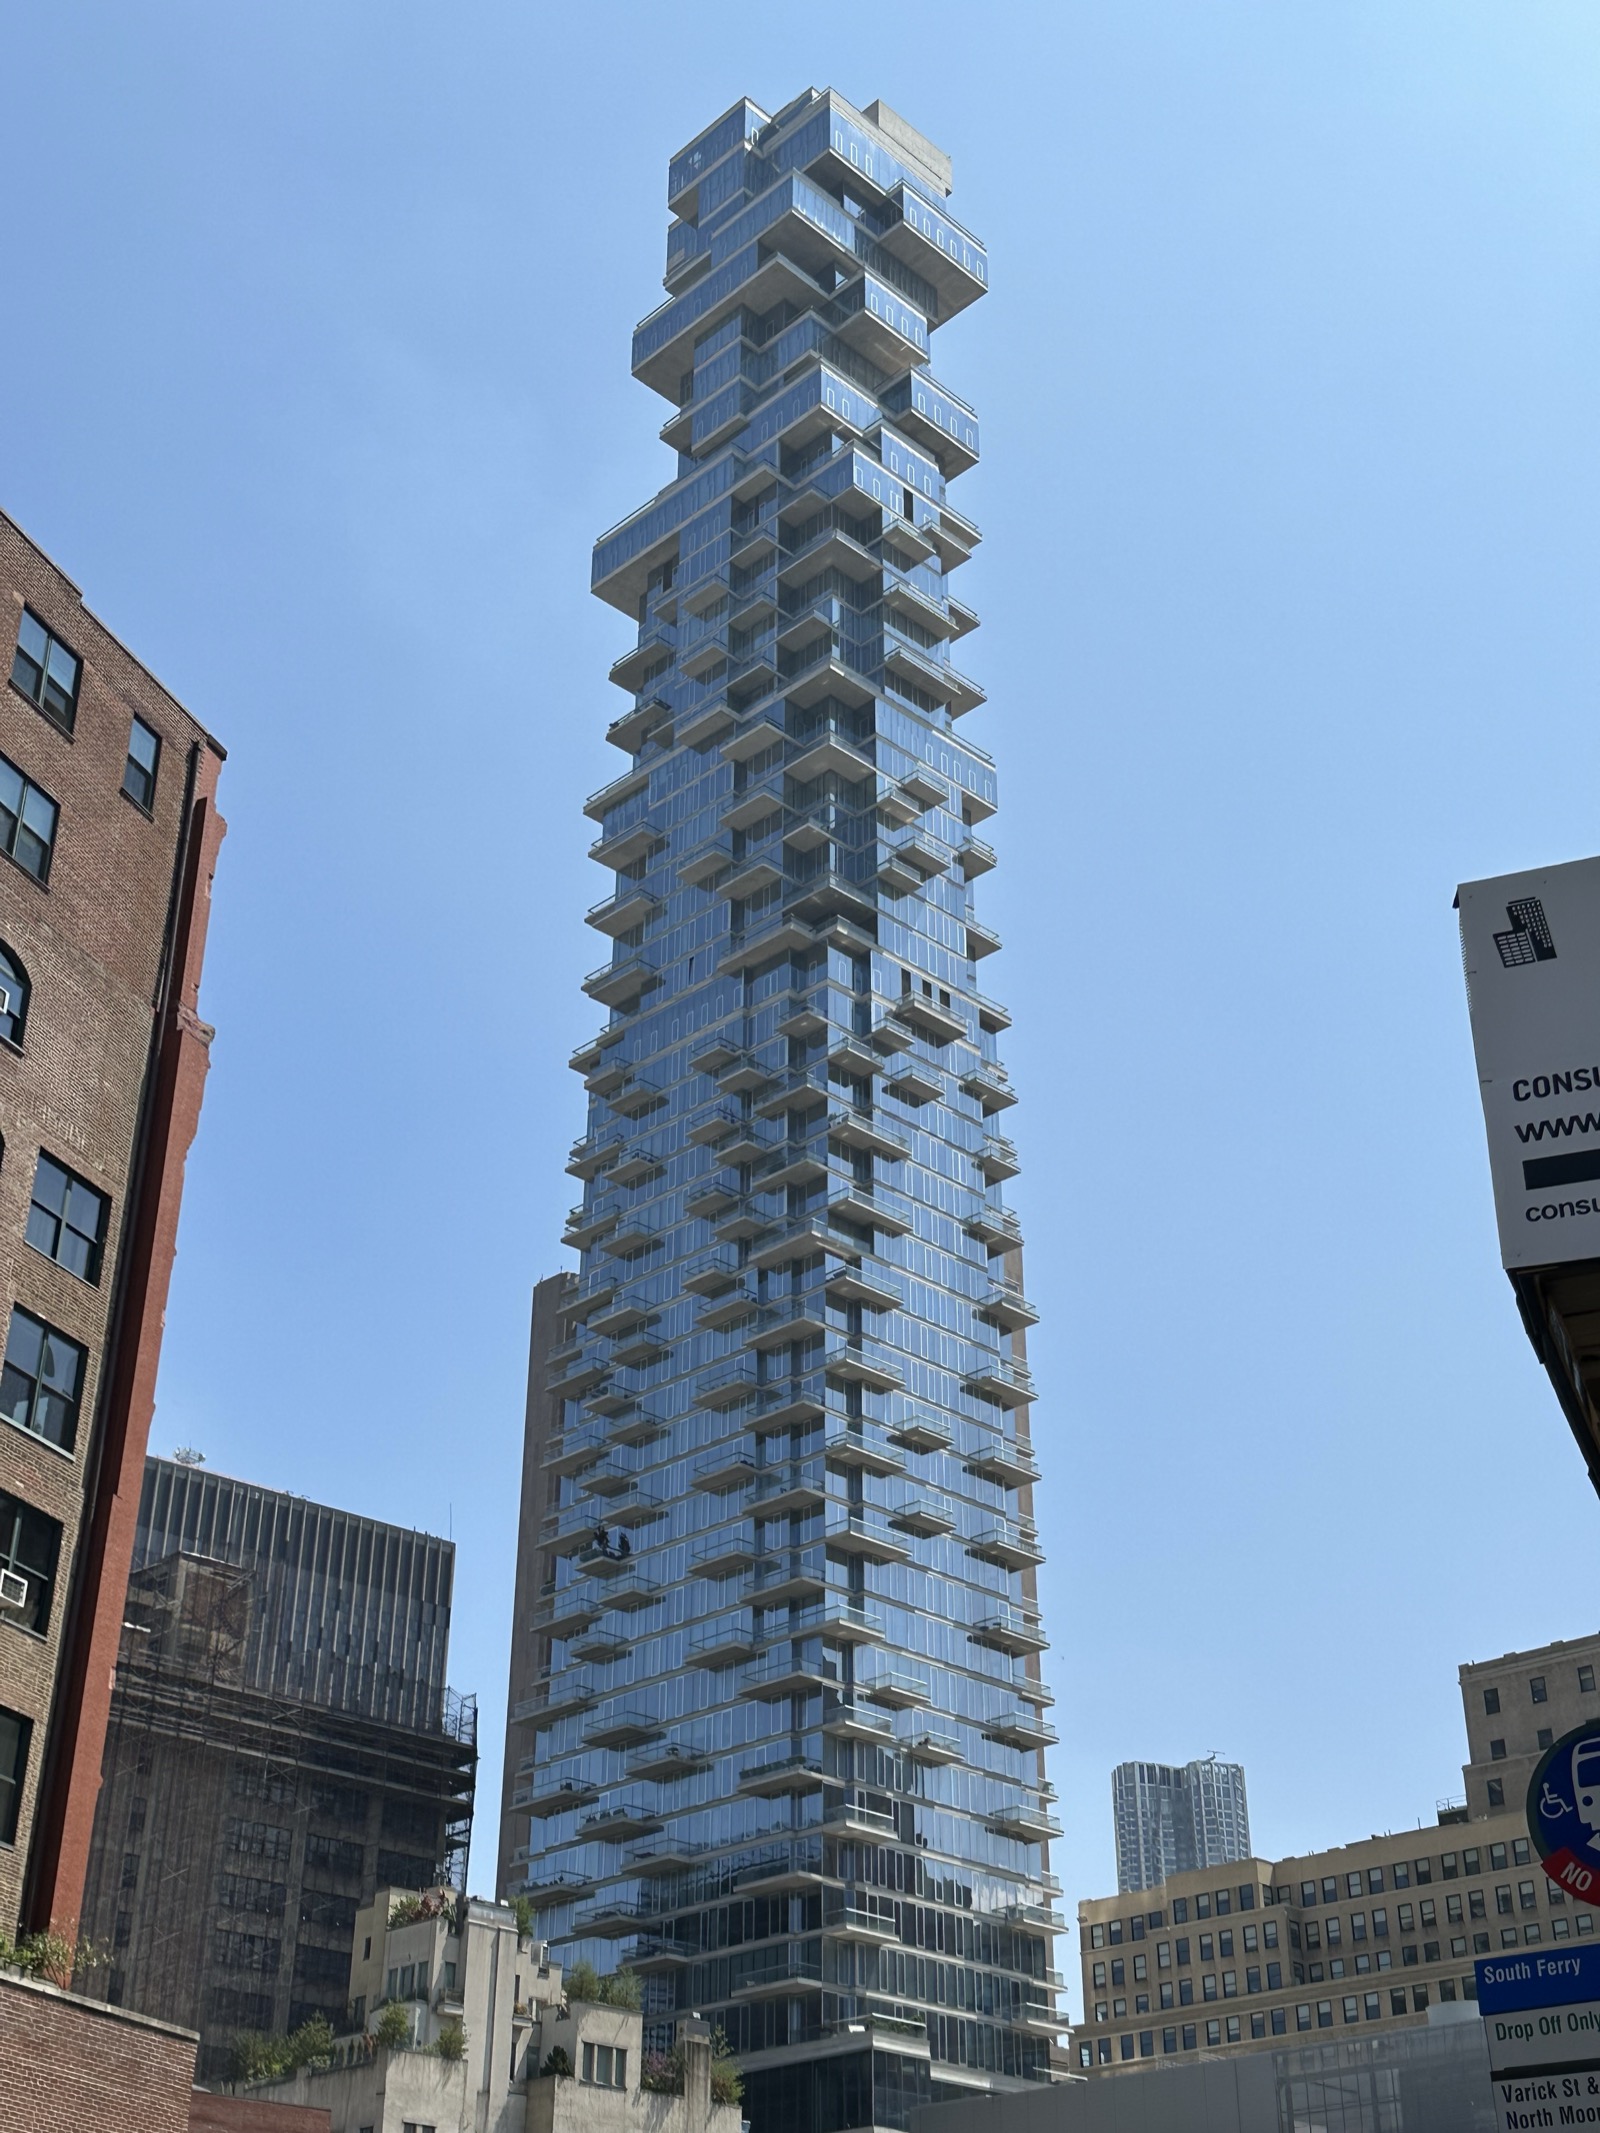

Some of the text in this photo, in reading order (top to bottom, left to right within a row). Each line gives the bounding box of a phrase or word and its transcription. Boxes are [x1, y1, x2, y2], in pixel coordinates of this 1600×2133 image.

[1560, 1861, 1593, 1892] NO
[1484, 1958, 1581, 1984] South Ferry
[1495, 2010, 1600, 2042] Drop Off Only
[1501, 2076, 1600, 2103] Varick St &
[1506, 2108, 1554, 2131] North
